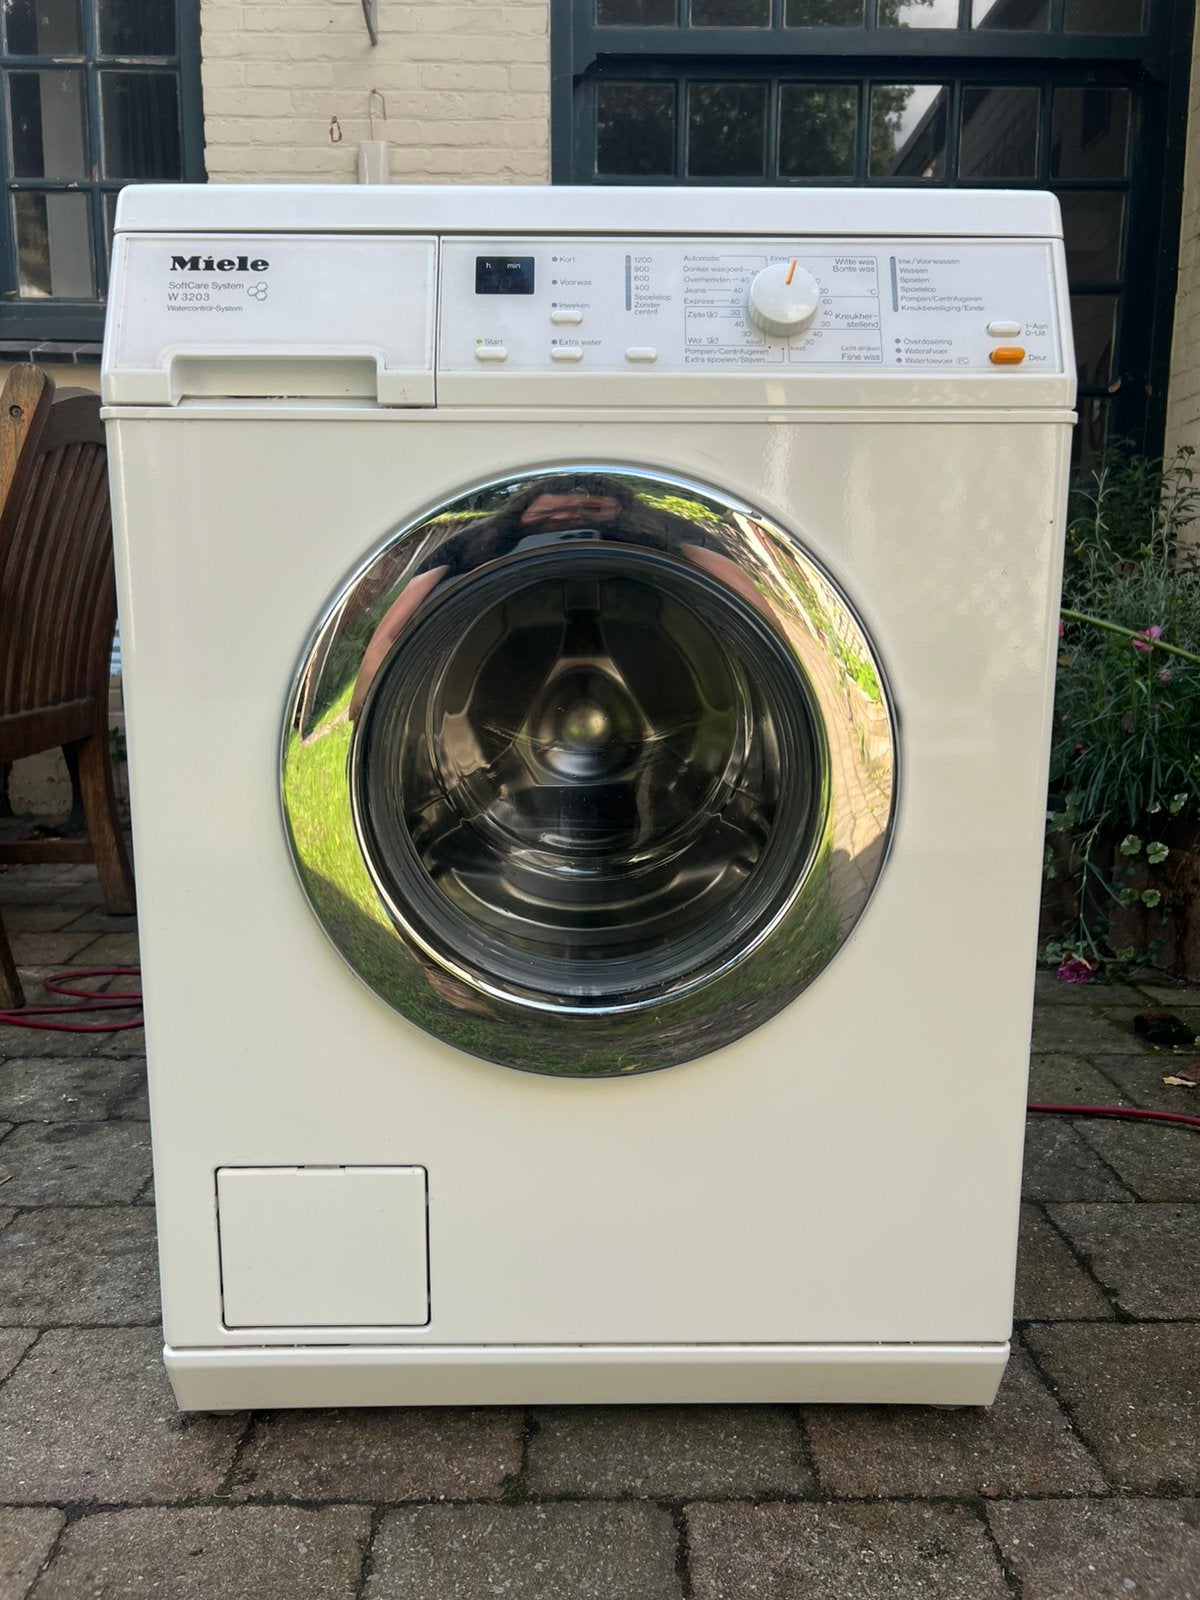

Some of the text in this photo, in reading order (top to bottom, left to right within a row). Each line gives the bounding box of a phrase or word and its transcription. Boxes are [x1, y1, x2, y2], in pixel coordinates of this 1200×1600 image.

[170, 255, 270, 272] Miele
[834, 258, 857, 266] Witte
[683, 265, 710, 273] Donker
[711, 265, 744, 273] wasgoed
[832, 265, 857, 273] Bonte
[683, 276, 731, 284] Overhemden
[899, 276, 931, 284] Spoelen
[168, 281, 245, 291] SoftCare System
[168, 293, 210, 302] W 3203
[683, 298, 715, 306] Express
[903, 338, 953, 346] Overdosering
[904, 347, 949, 355] Waterafvoer
[904, 357, 953, 365] Watertoevoer
[1028, 354, 1047, 362] Deur
